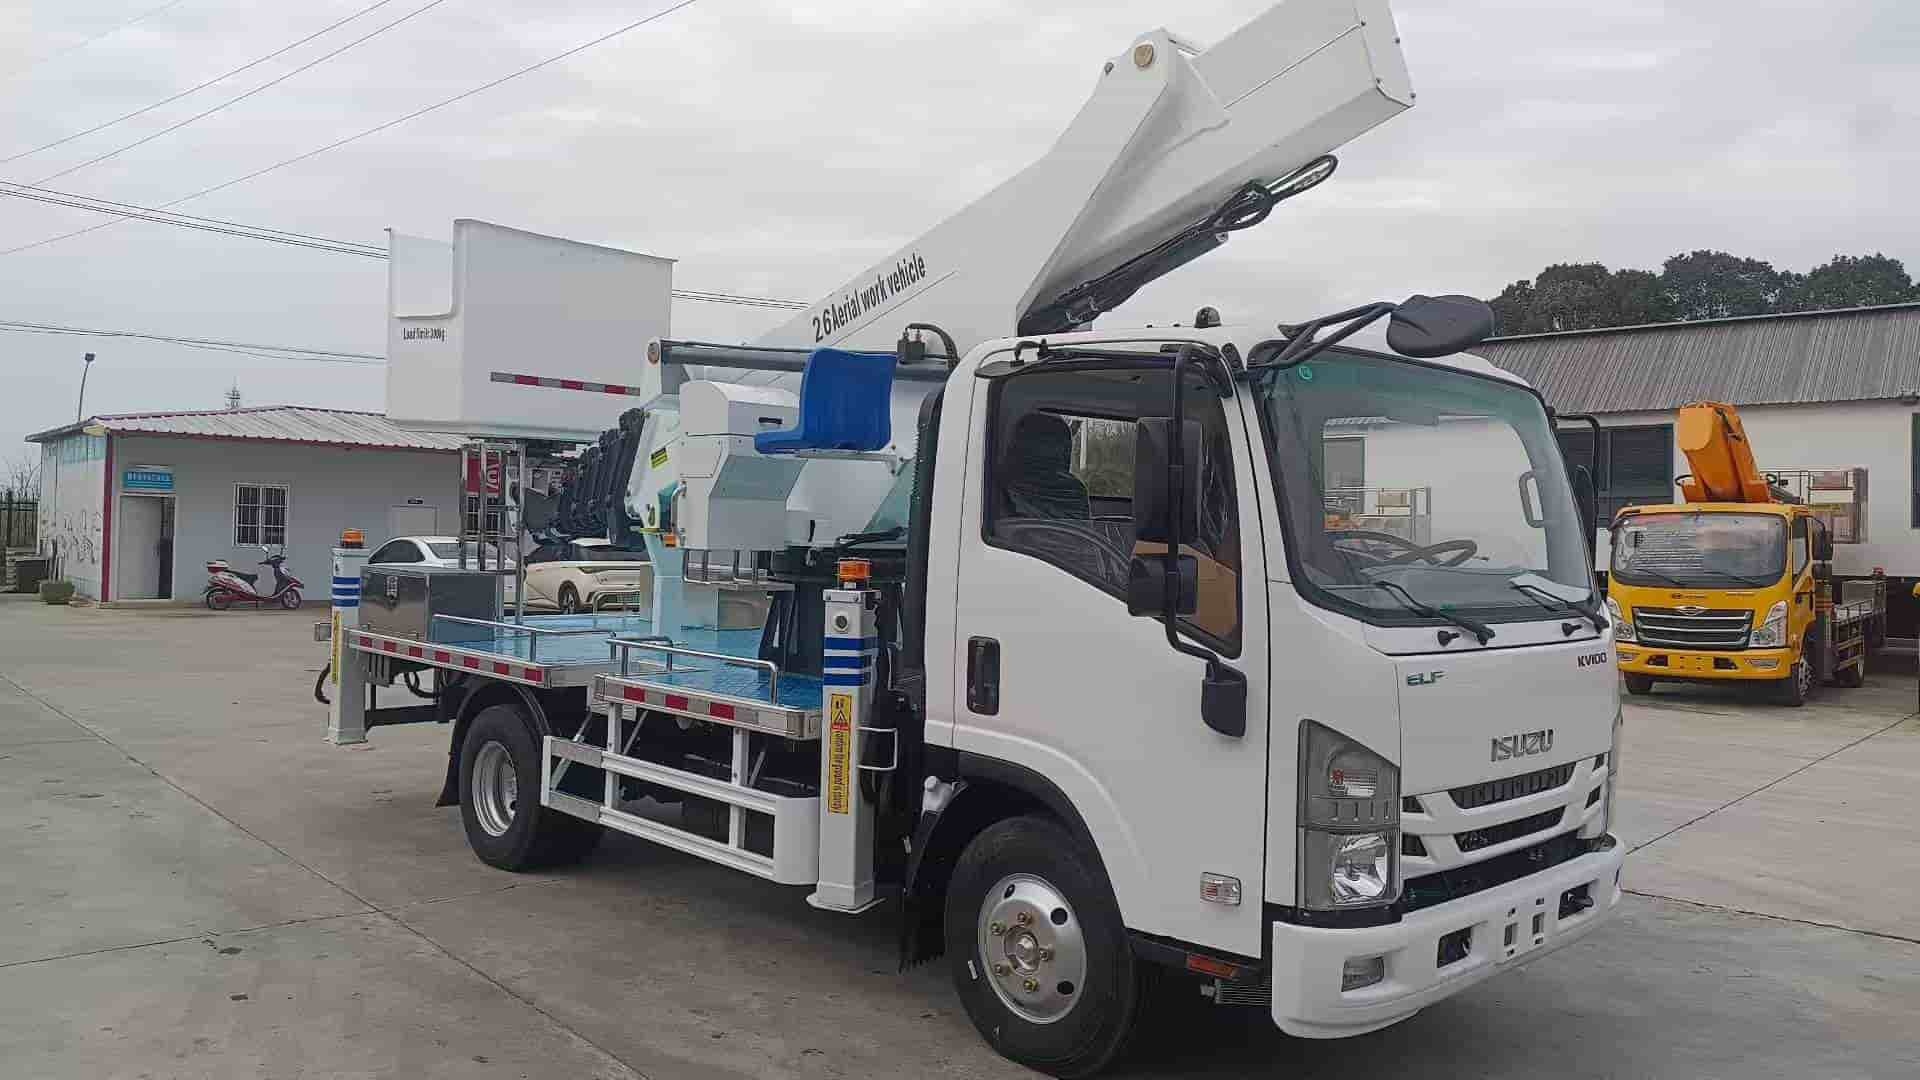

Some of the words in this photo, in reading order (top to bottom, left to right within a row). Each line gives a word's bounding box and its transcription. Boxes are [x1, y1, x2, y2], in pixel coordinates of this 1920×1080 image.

[861, 273, 888, 312] work
[886, 252, 926, 296] vehicle
[1577, 652, 1607, 668] KV100
[1407, 671, 1447, 687] ELF
[1491, 729, 1554, 762] ISUZU
